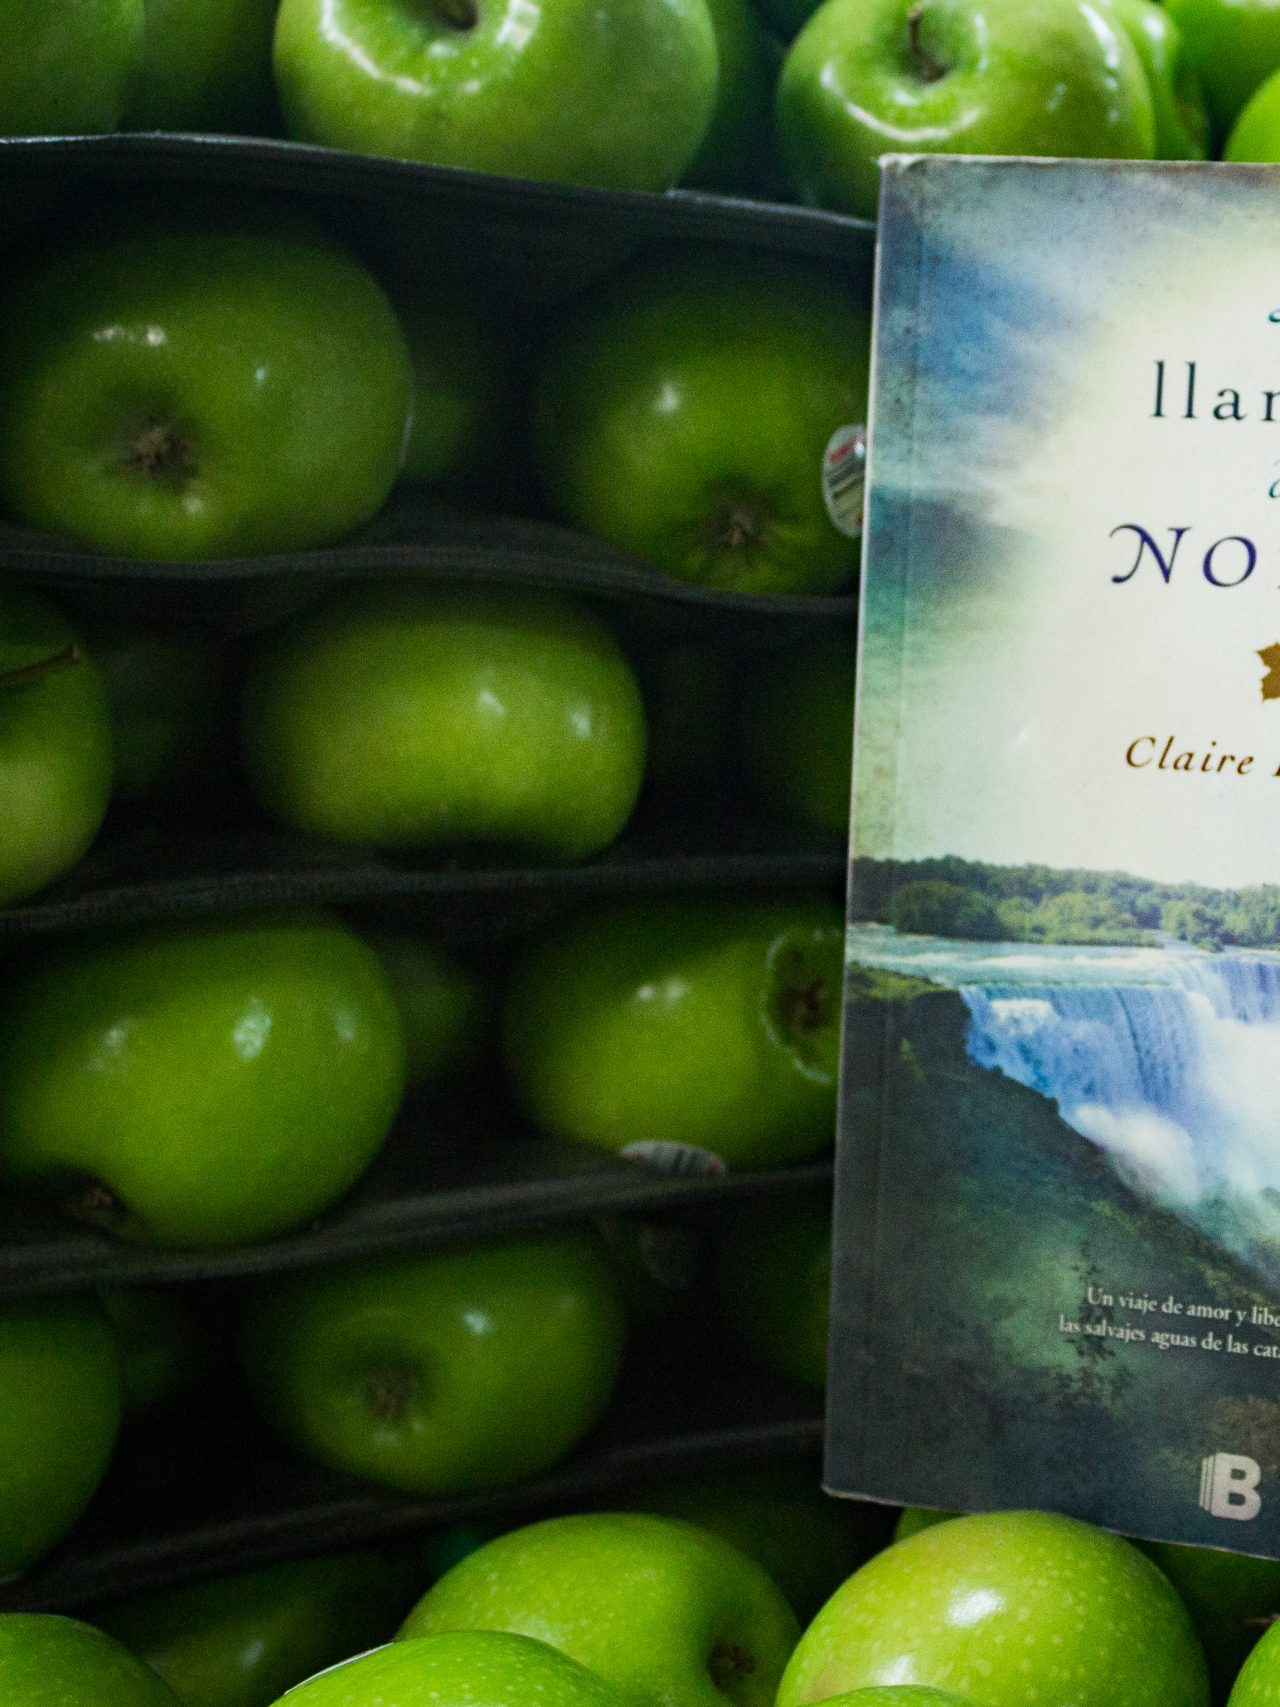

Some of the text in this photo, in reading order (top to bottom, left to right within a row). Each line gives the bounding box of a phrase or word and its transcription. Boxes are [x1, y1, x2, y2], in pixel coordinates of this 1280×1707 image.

[1125, 735, 1254, 775] Claire
[1087, 1286, 1113, 1306] Un
[1119, 1292, 1157, 1314] viaje
[1161, 1296, 1182, 1315] de
[1187, 1304, 1231, 1321] amor
[1236, 1310, 1247, 1327] y
[1059, 1314, 1080, 1333] las
[1085, 1319, 1146, 1343] salvajes
[1151, 1331, 1197, 1349] aguas
[1201, 1332, 1222, 1351] de
[1227, 1334, 1249, 1354] las
[1200, 1452, 1262, 1521] B
